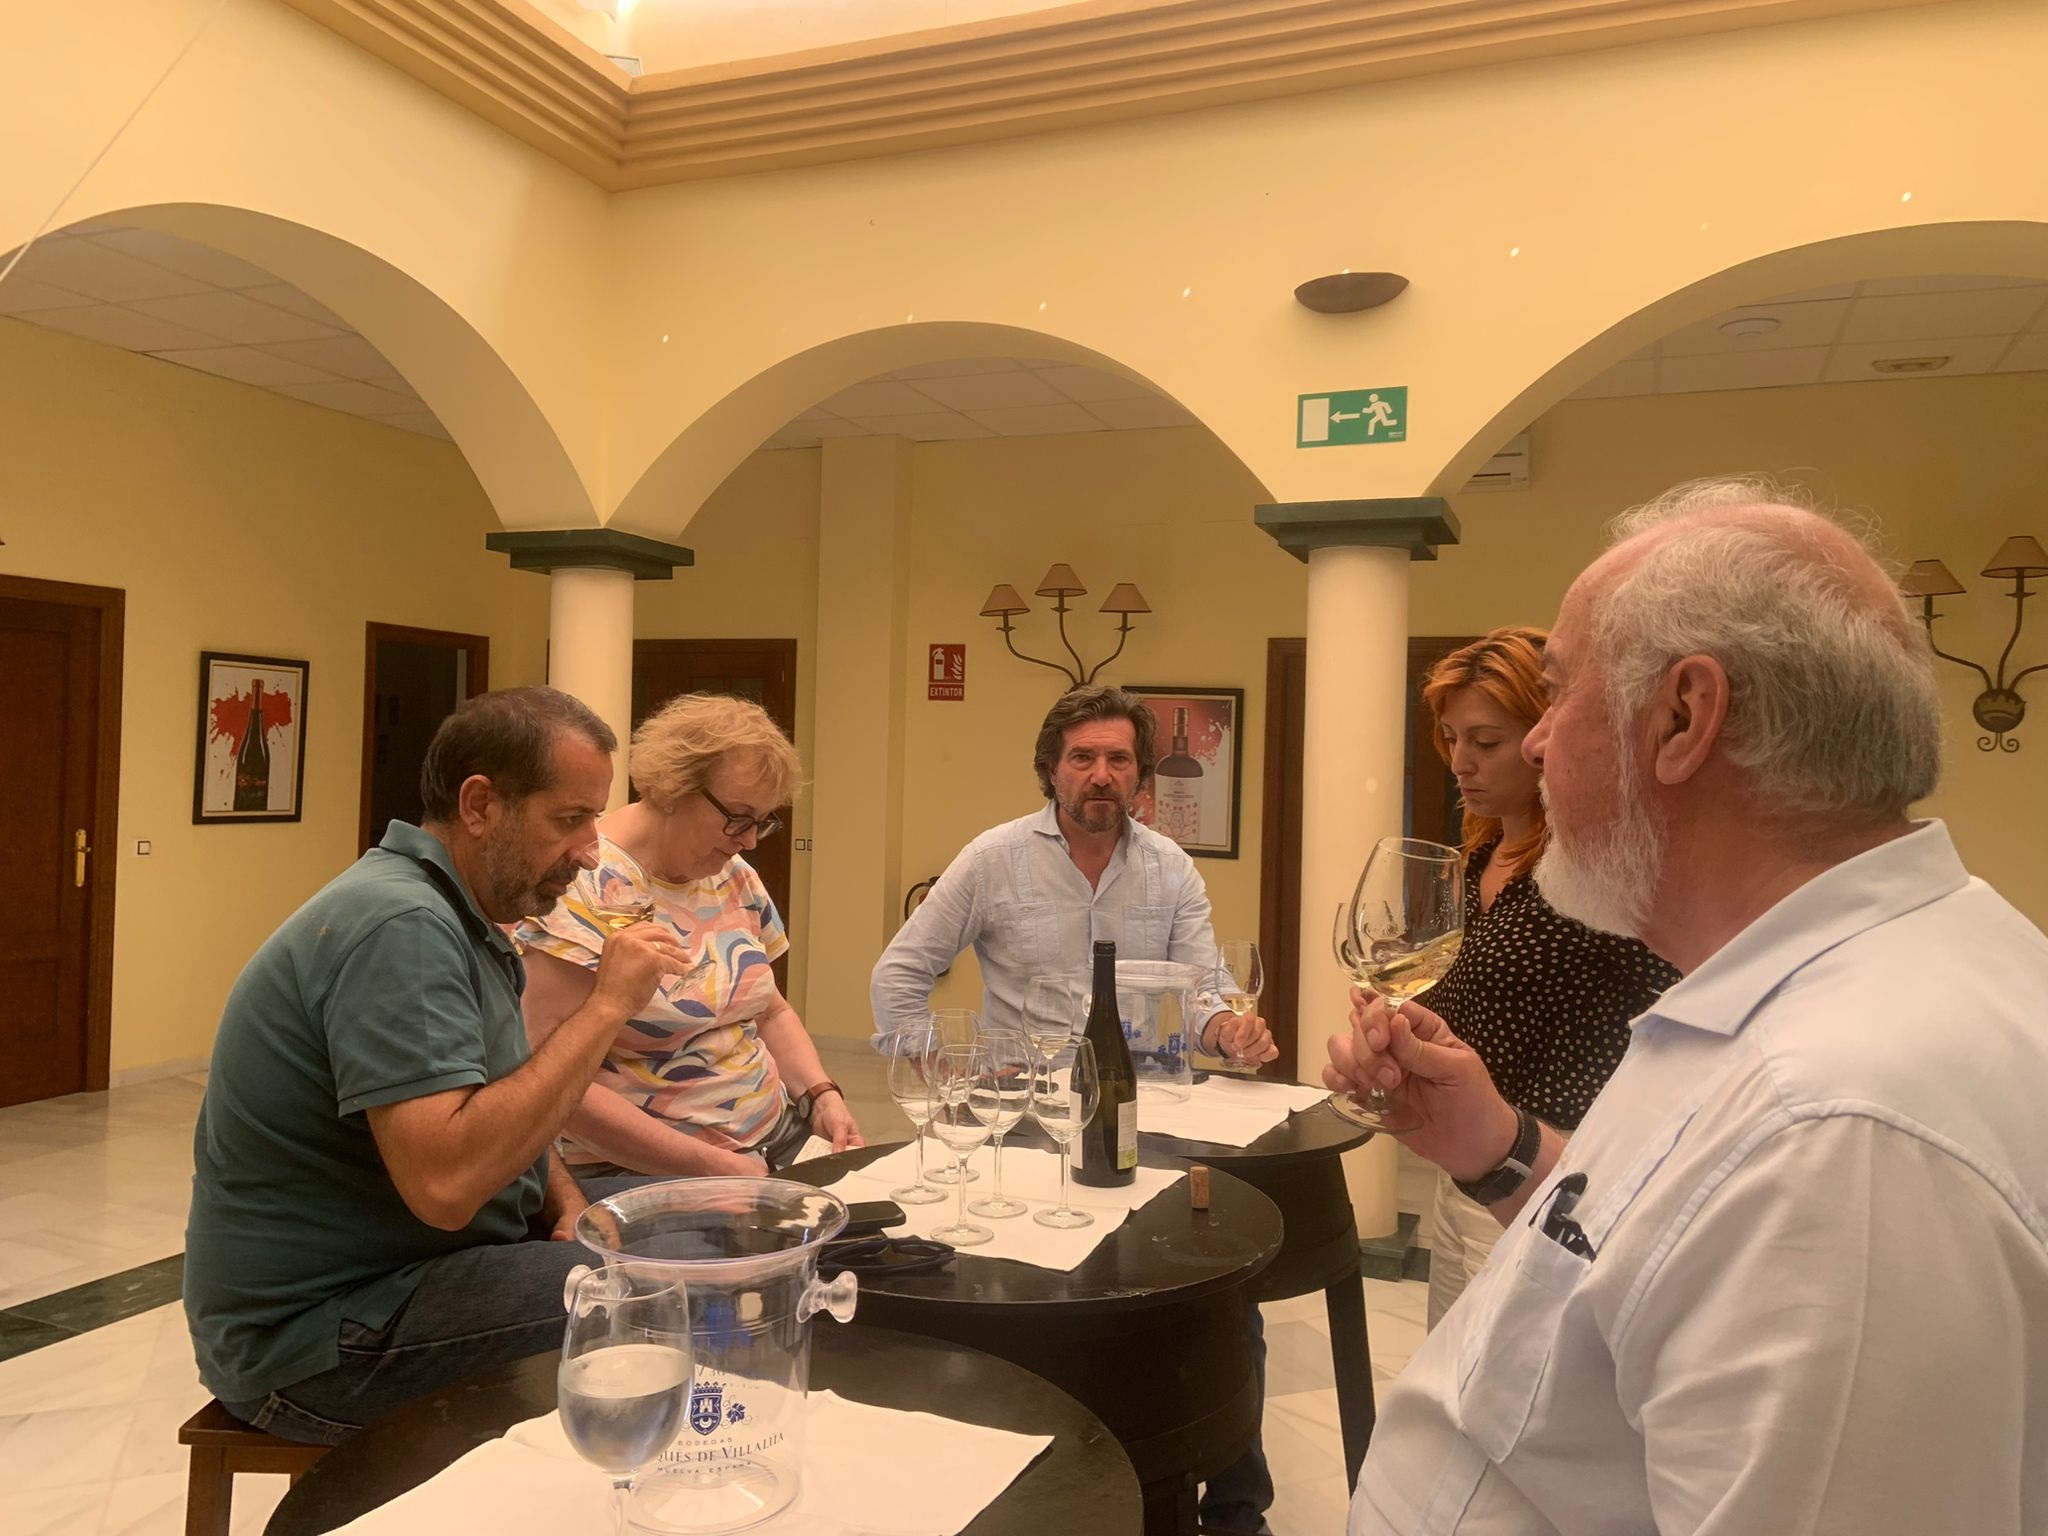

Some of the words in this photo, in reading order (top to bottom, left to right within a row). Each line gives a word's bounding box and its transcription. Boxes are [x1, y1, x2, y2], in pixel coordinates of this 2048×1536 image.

[930, 687, 963, 697] EXTINTOR
[678, 1437, 733, 1446] BODEGAS
[698, 1451, 717, 1462] DE
